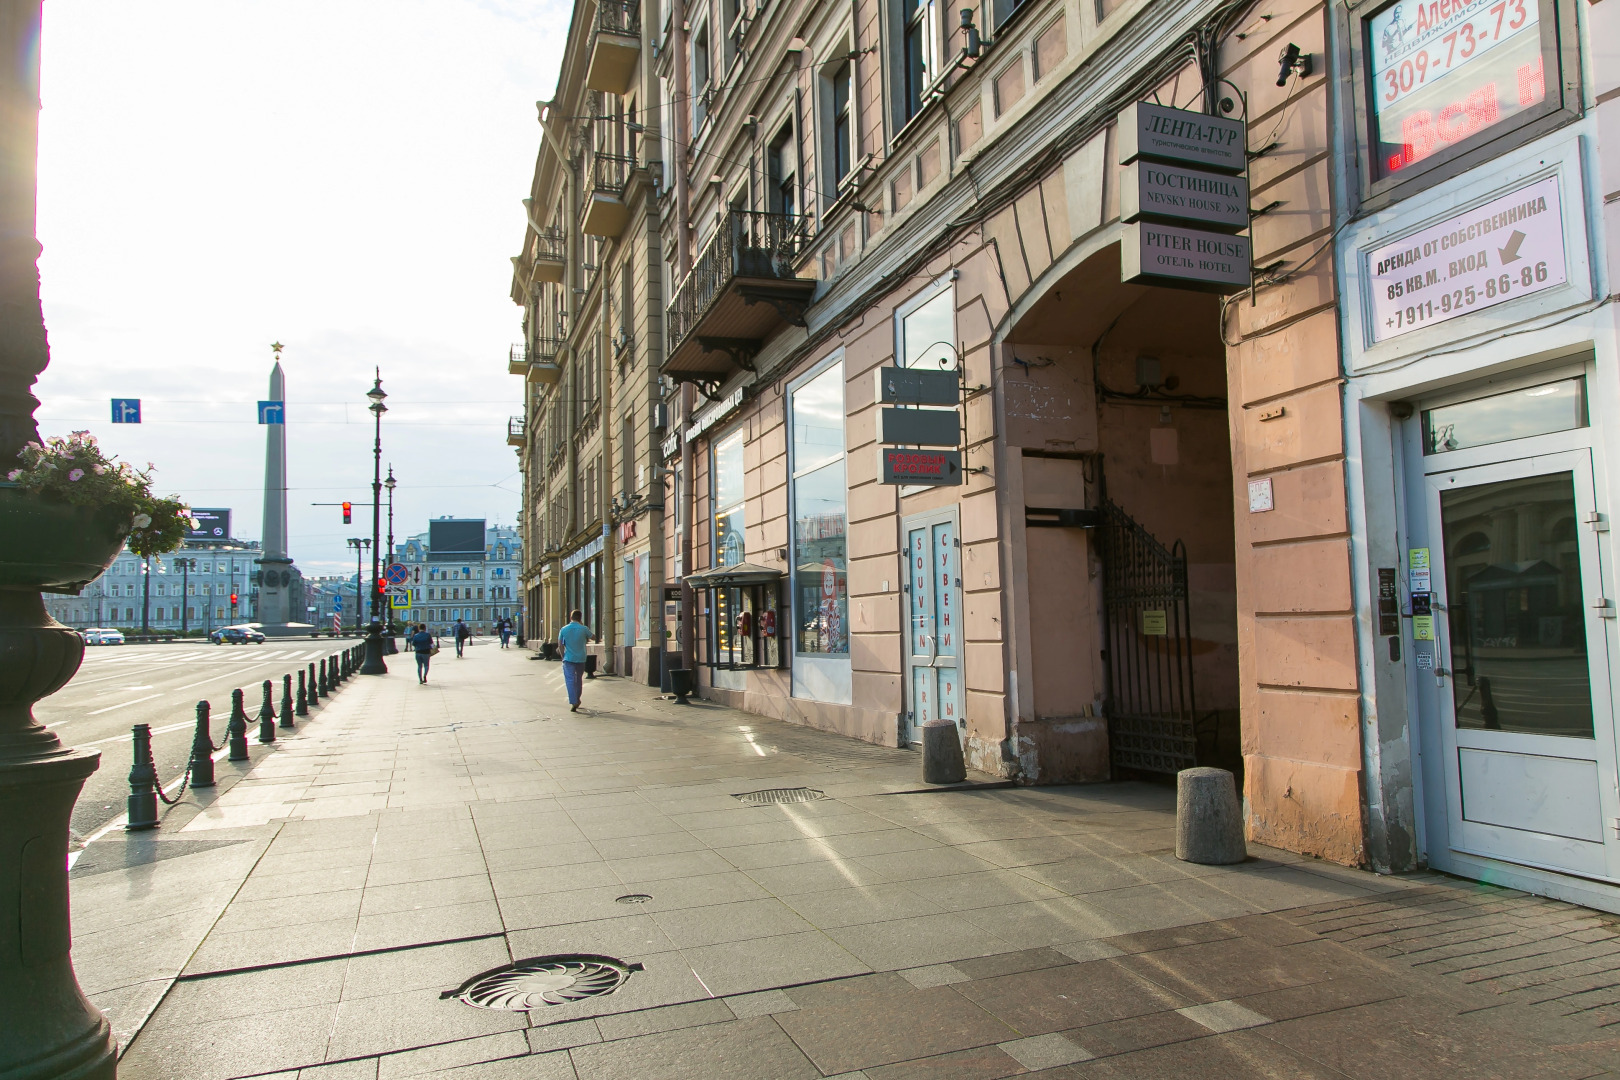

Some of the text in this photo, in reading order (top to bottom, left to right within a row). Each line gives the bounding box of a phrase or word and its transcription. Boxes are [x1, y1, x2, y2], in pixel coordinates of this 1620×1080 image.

[1384, 0, 1527, 102] 309-73-73
[1145, 115, 1237, 147] ЛЕНТА-ТУР
[1152, 138, 1232, 158] туристическое агентство
[1147, 170, 1239, 198] ГОСТИНИЦА
[1147, 191, 1221, 213] NEVSKY HOUSE
[1146, 231, 1244, 259] PITER HOUSE
[1377, 196, 1548, 276] АРЕНДА ОТ СОБСТВЕННИКА
[1157, 254, 1234, 274] ОТЕЛЬ HOTEL
[1387, 281, 1404, 300] 85
[1448, 249, 1488, 278] ВХОД
[888, 453, 946, 464] РОЗОВЫЙ
[893, 464, 941, 474] КРОЛИК
[917, 537, 927, 721] SOUVENIRS
[942, 533, 953, 716] СУВЕНИРЫ
